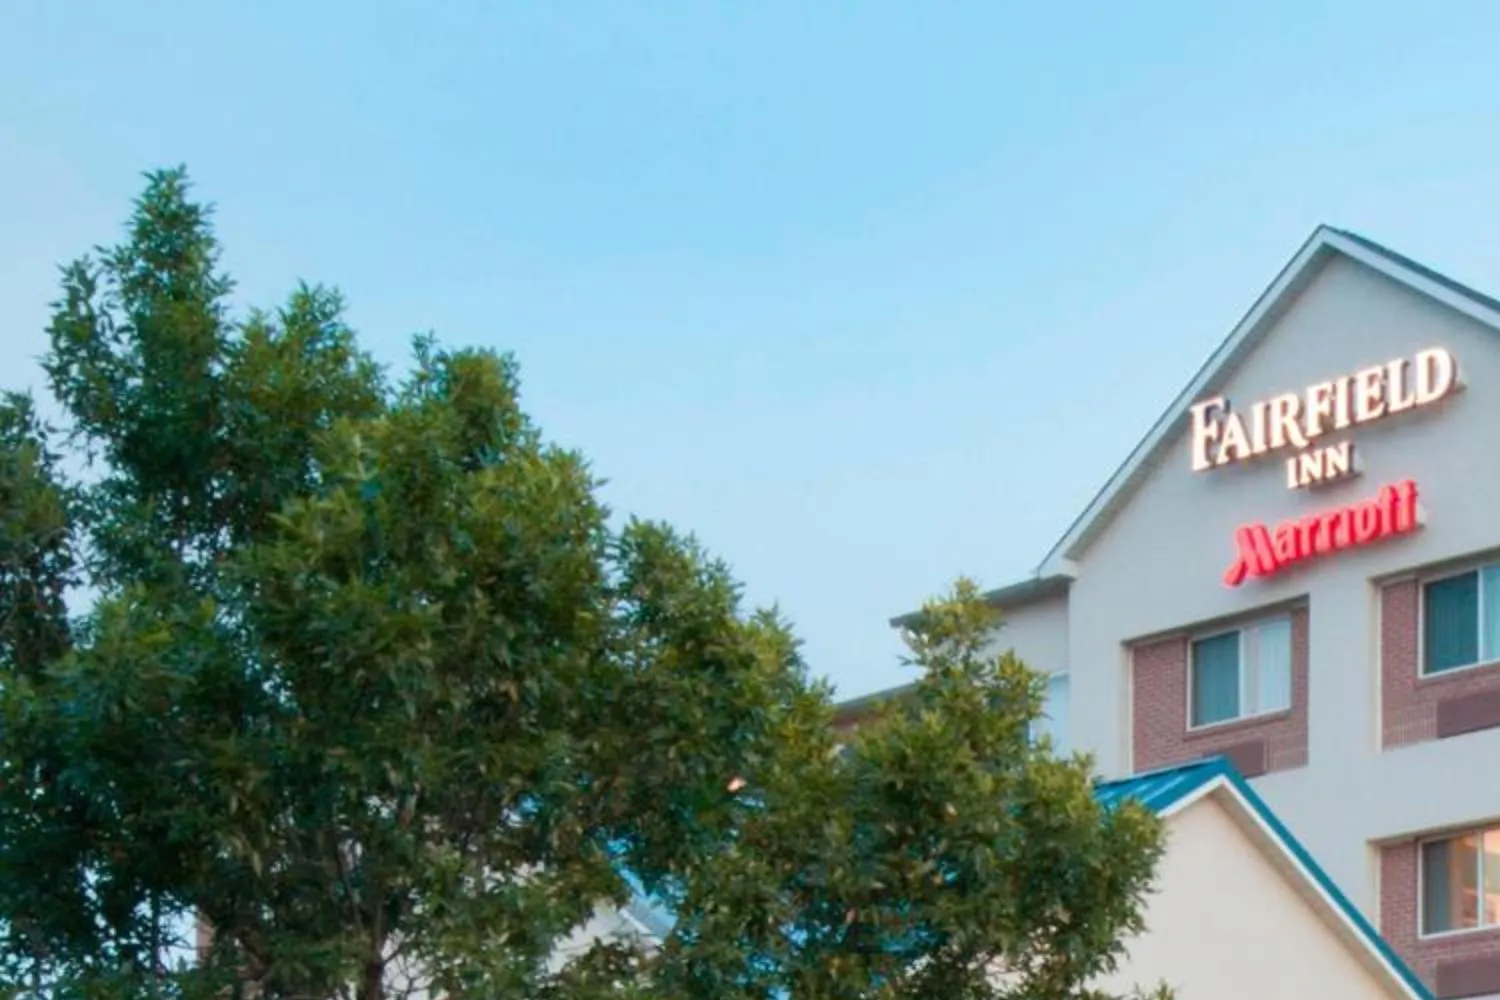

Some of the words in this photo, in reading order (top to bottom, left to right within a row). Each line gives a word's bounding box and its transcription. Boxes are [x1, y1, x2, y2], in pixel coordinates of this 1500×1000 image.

[1189, 346, 1456, 471] FAIRFIELD
[1285, 441, 1351, 489] INN
[1223, 479, 1417, 587] Marriott
